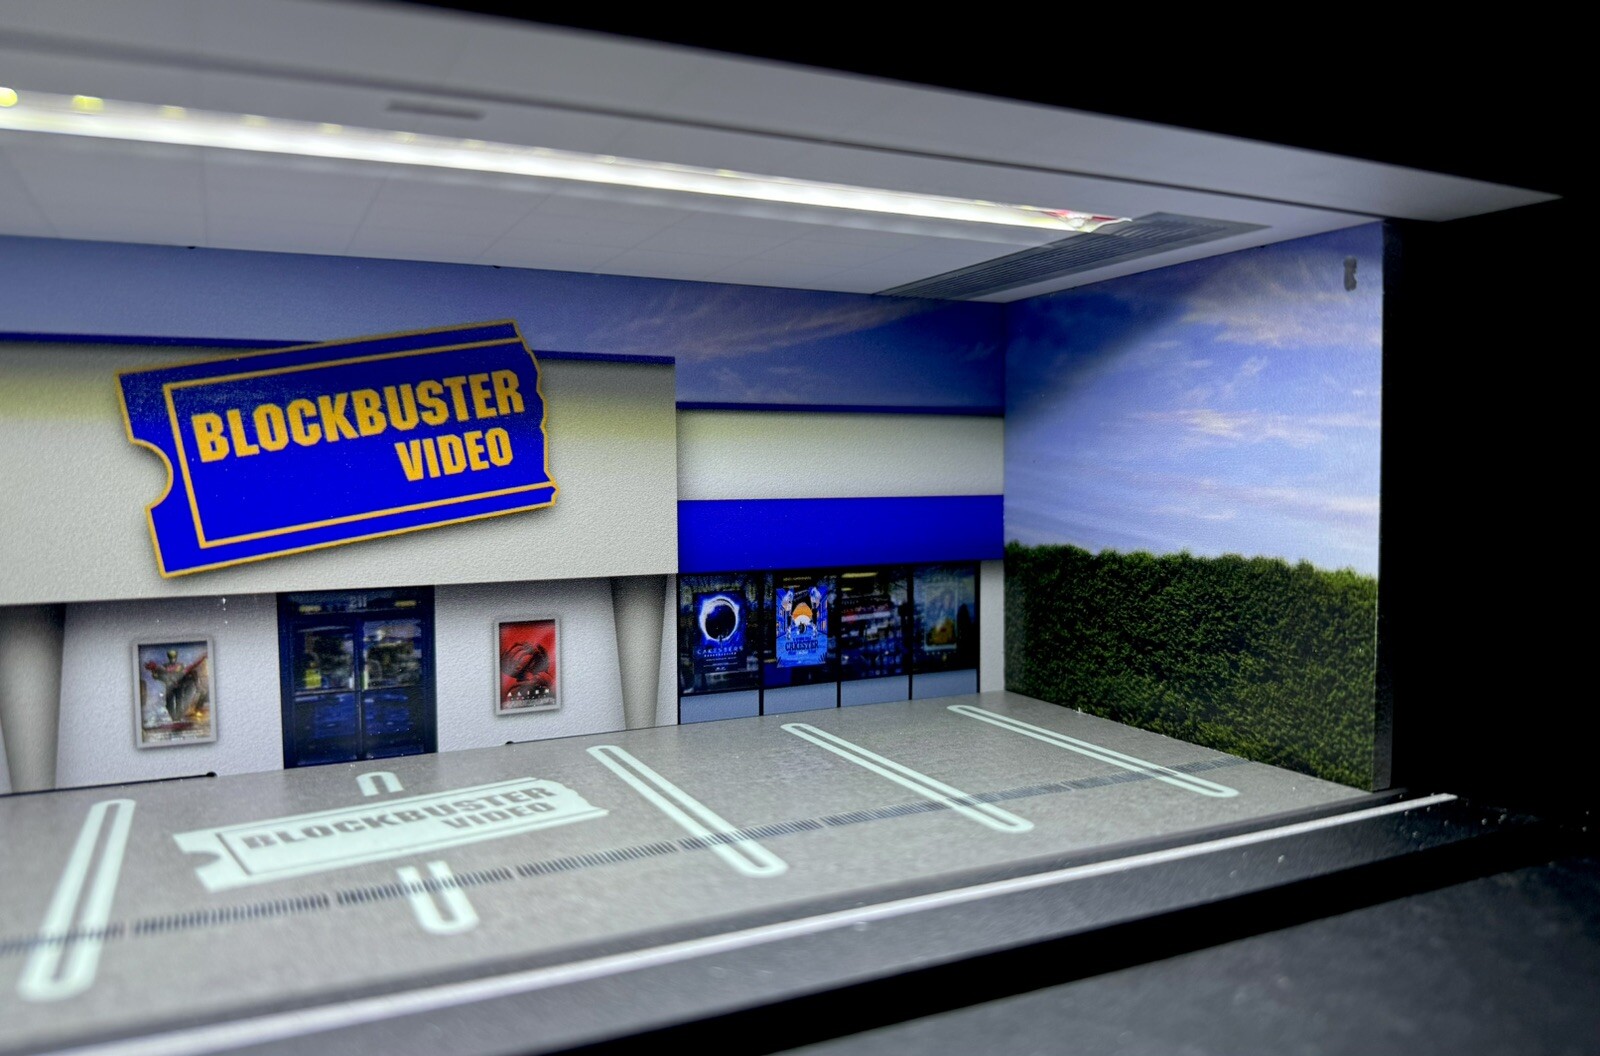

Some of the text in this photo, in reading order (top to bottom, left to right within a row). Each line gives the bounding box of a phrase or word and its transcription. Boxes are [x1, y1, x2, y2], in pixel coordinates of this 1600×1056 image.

[191, 368, 525, 463] BLOCKBUSTER
[395, 427, 513, 482] VIDEO
[242, 786, 559, 849] BLOCKBUSTER
[441, 801, 557, 831] VIDEO
